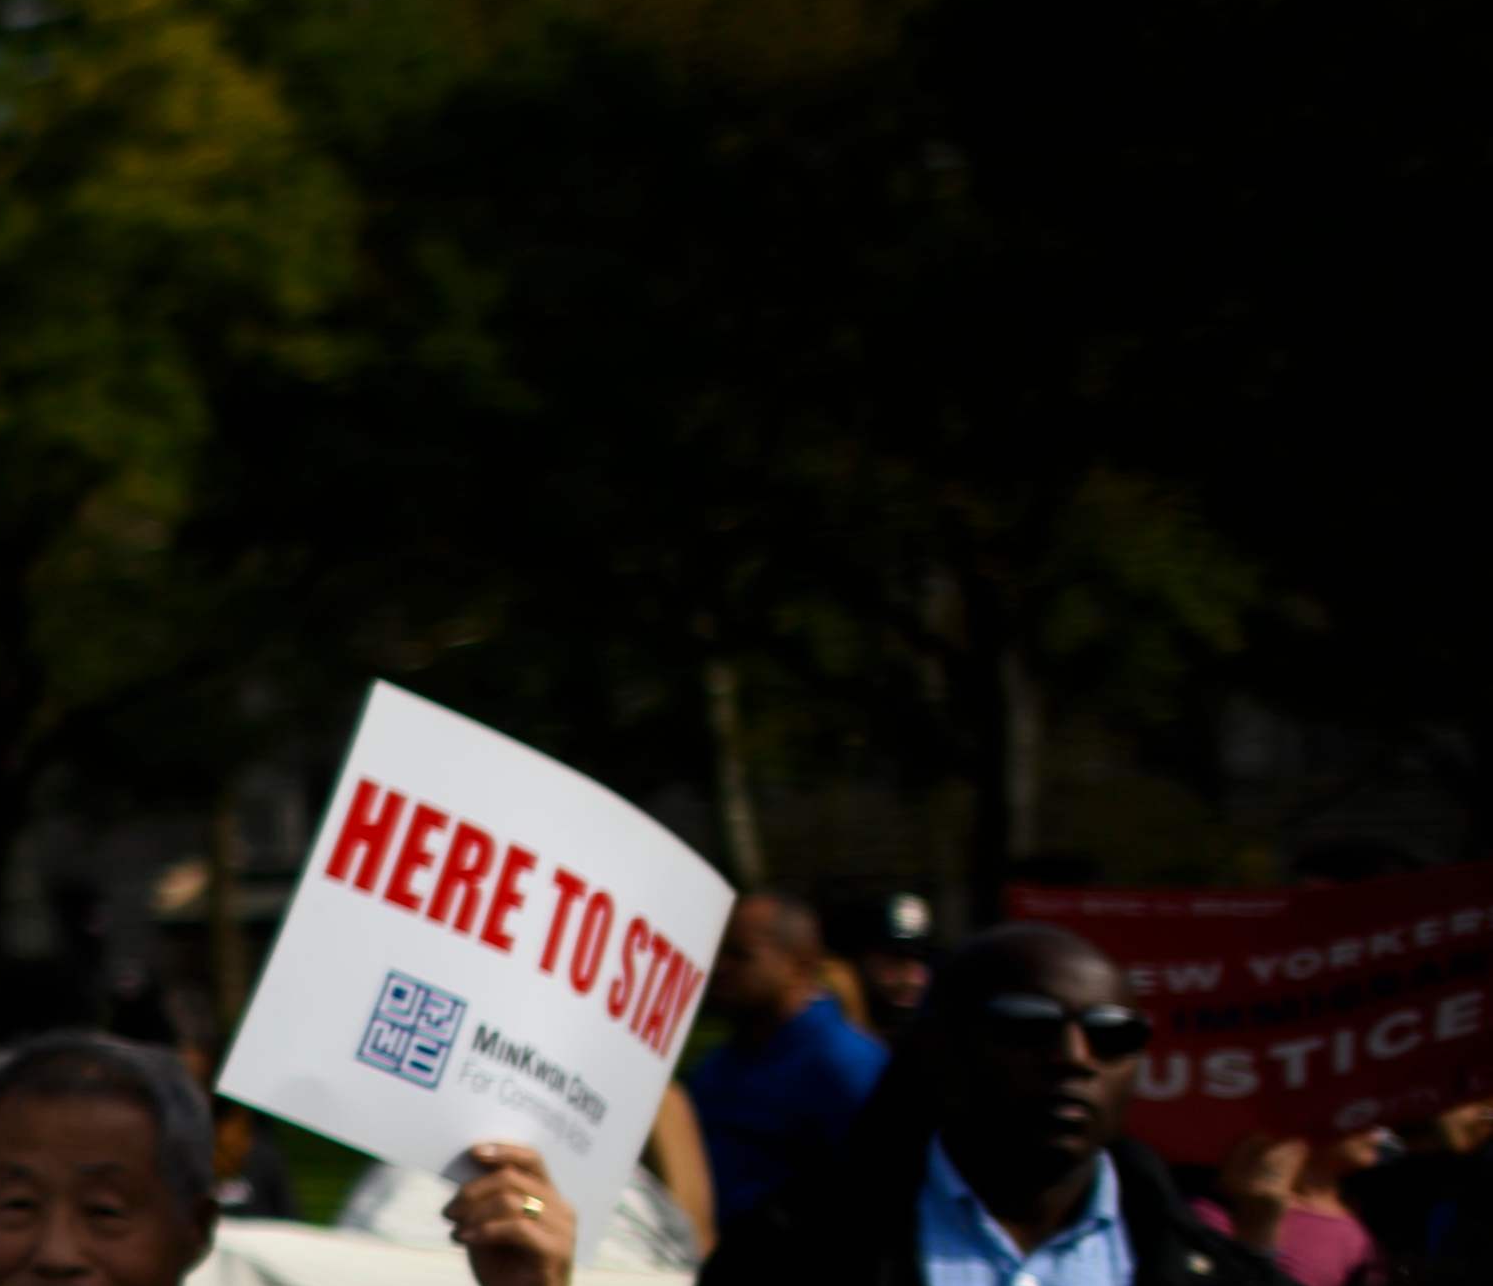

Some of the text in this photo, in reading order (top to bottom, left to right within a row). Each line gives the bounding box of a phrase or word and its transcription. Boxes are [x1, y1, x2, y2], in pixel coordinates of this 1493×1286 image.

[324, 778, 704, 1059] HERE TO STAY
[1127, 961, 1222, 995] EW
[1245, 904, 1493, 985] YORKER
[1131, 992, 1484, 1102] USTICE
